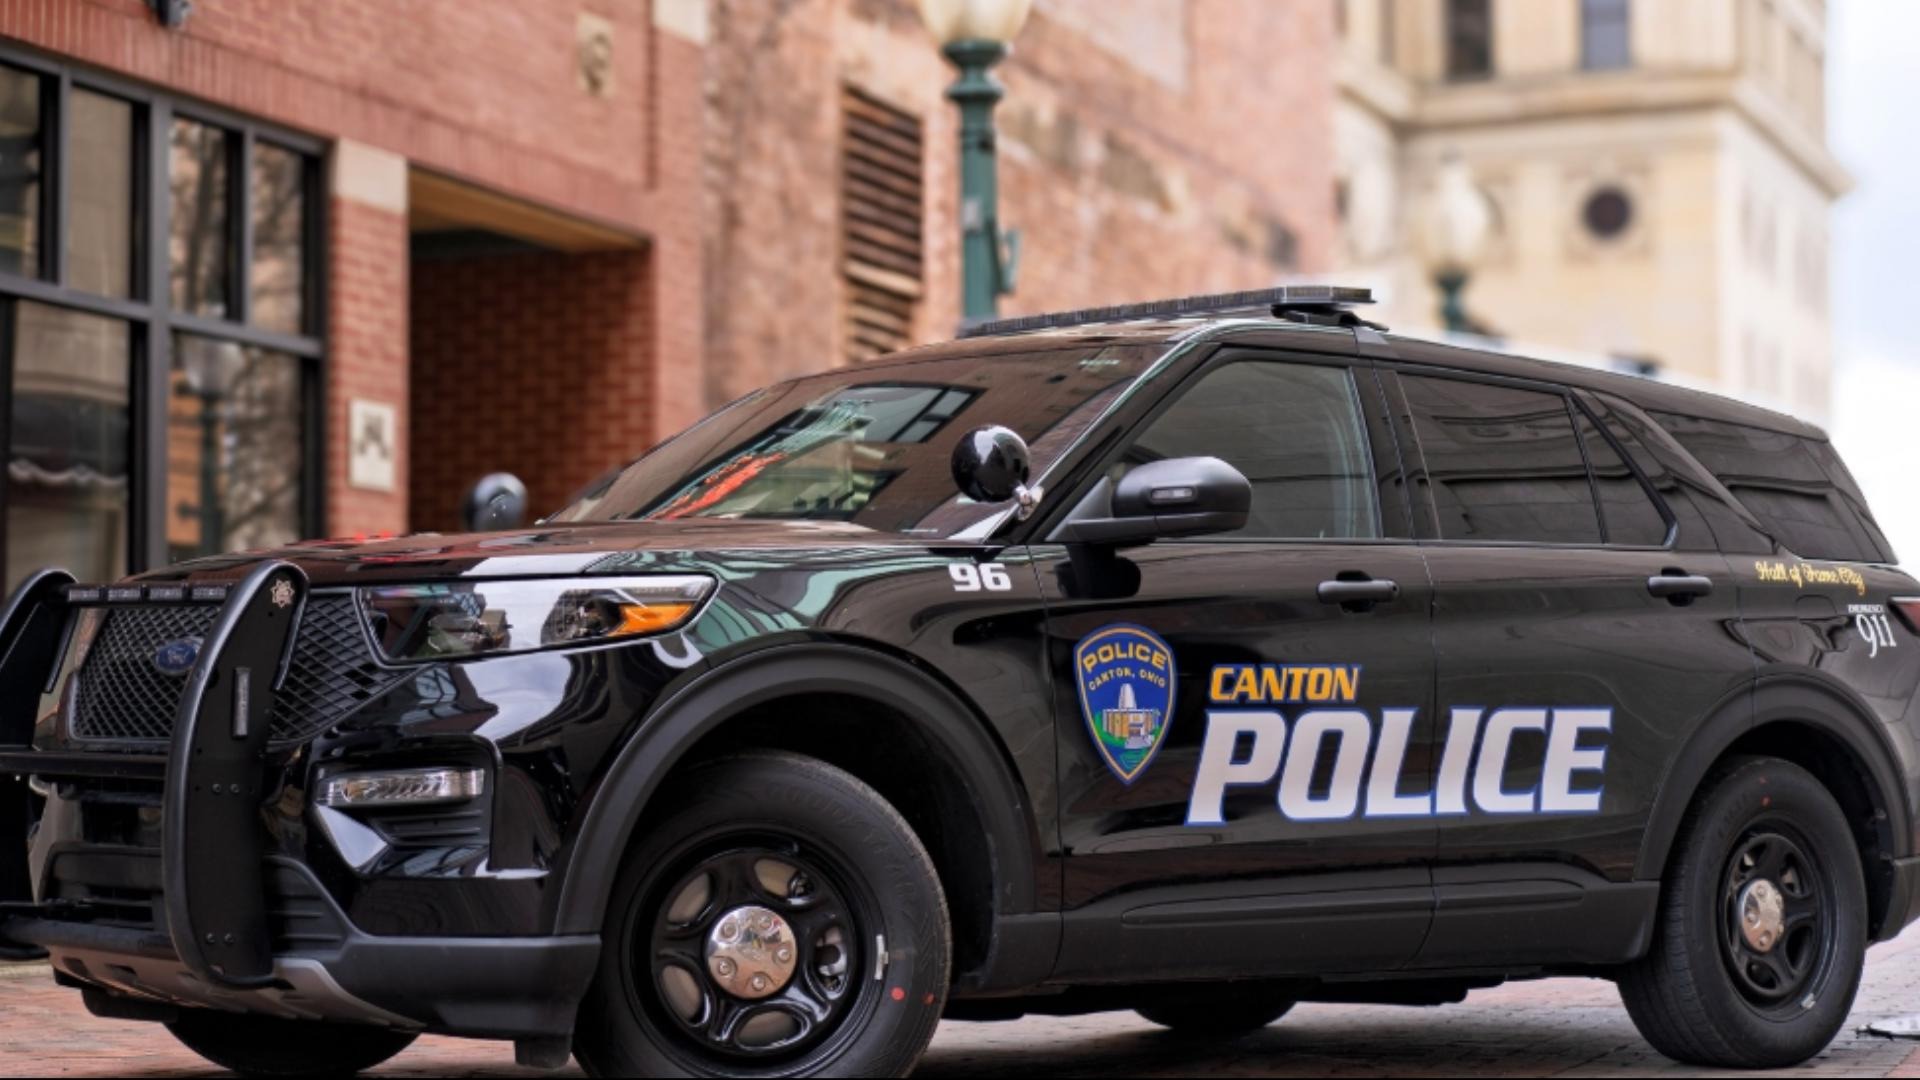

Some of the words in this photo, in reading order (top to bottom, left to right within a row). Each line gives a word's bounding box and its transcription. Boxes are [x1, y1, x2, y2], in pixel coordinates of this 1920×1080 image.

[949, 563, 1012, 591] 96
[1755, 561, 1789, 582] Hall
[1789, 564, 1802, 588] of
[1802, 563, 1839, 583] Fame
[1836, 566, 1865, 595] City
[1856, 614, 1896, 658] 911
[1083, 642, 1167, 674] POLICE
[1089, 667, 1136, 691] CANTON,
[1140, 669, 1166, 688] OHIO
[1210, 665, 1361, 702] CANTON
[1185, 706, 1613, 826] POLICE
